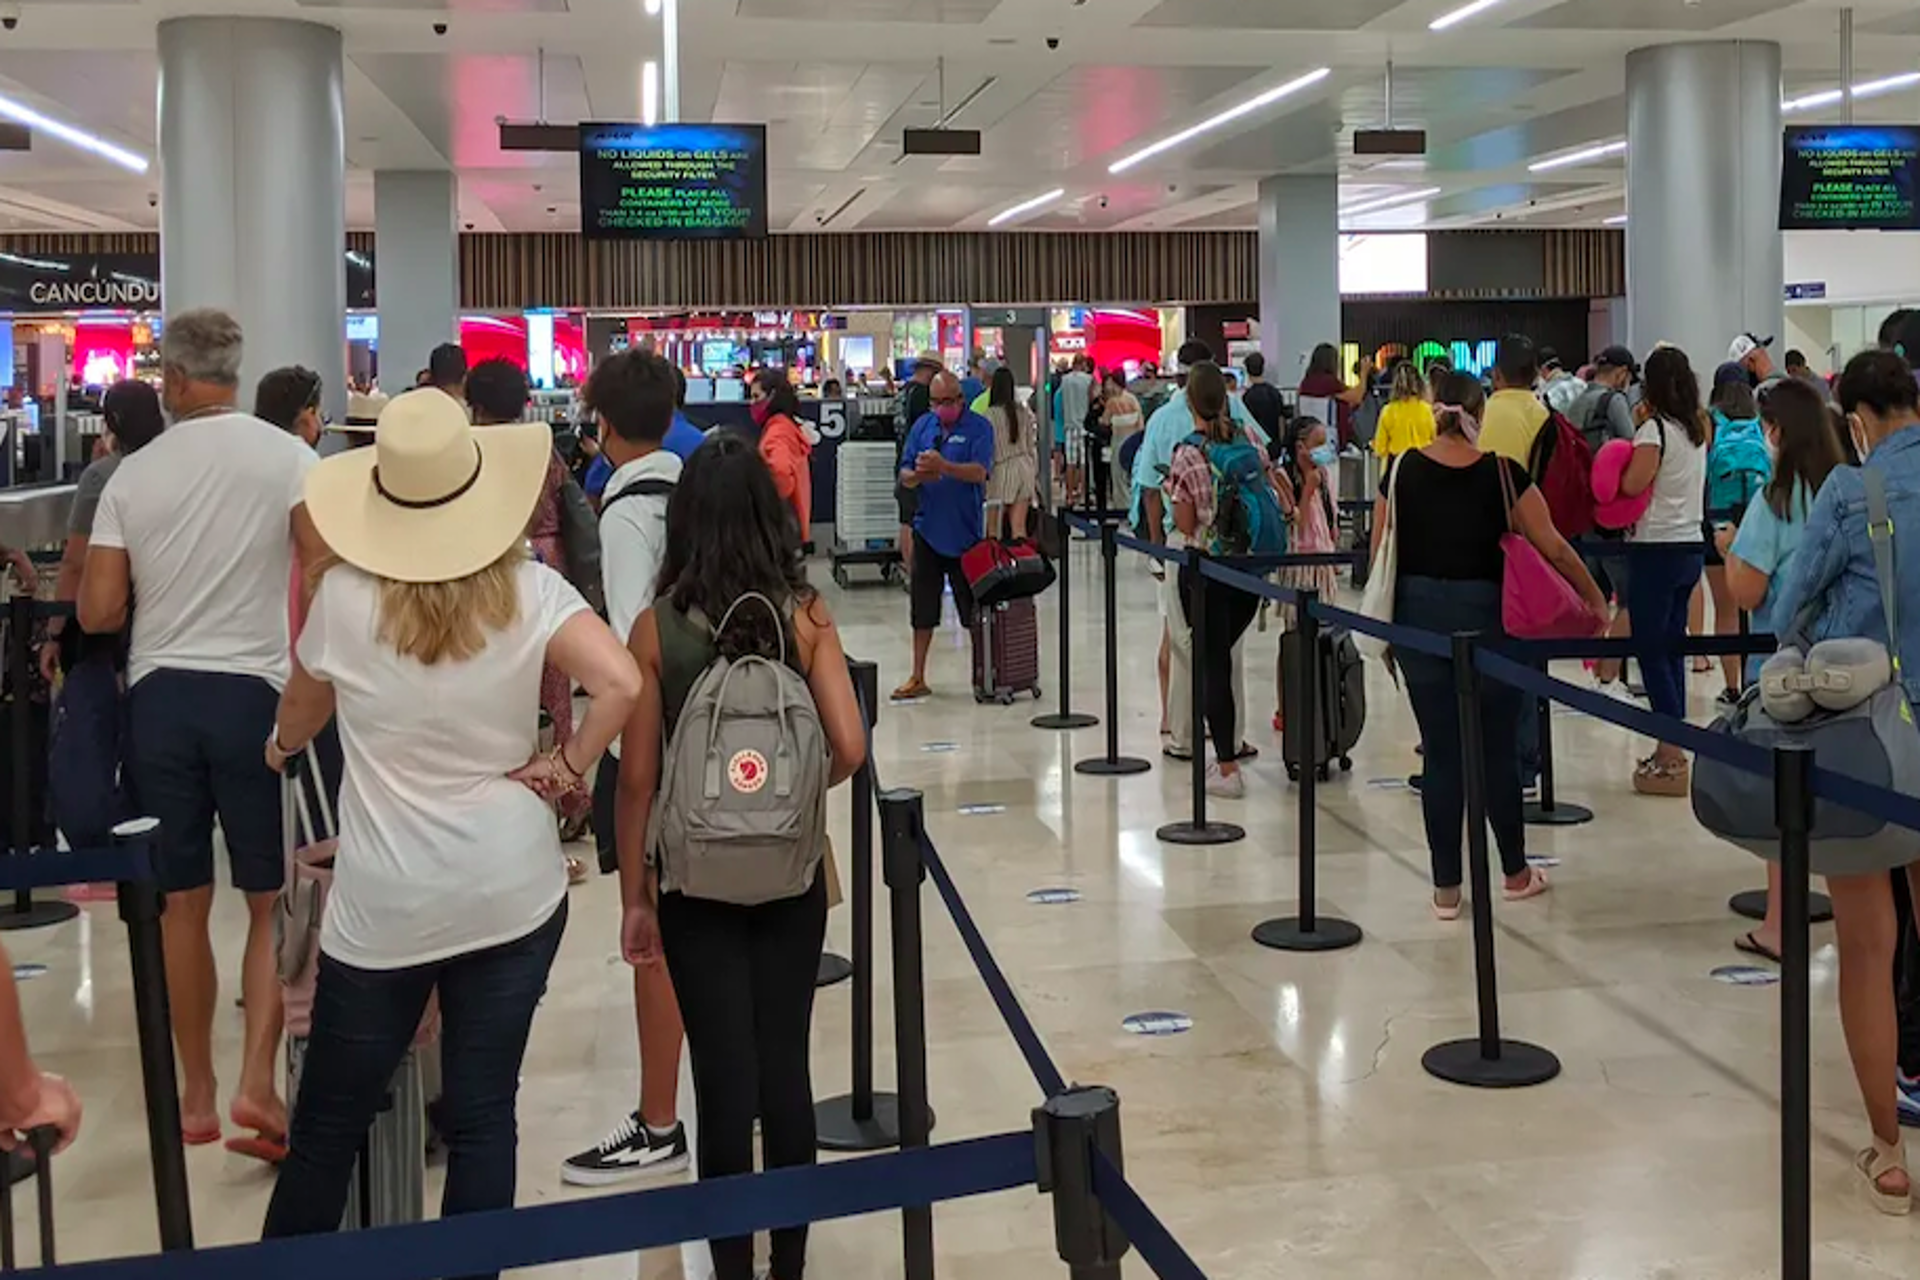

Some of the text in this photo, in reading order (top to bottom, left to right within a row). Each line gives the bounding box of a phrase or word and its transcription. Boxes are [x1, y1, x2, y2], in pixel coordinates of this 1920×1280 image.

[597, 149, 618, 159] NO
[621, 149, 675, 159] LIQUIDS
[694, 149, 728, 159] GELS
[1797, 149, 1814, 158] NO
[1816, 149, 1857, 158] LIQUIDS
[1873, 149, 1900, 158] GELS
[612, 161, 735, 170] ALLOWED THROUGH THE
[630, 170, 681, 179] SECURITY
[1822, 168, 1861, 176] SECURITY
[1812, 182, 1853, 192] PLEASE
[621, 187, 728, 198] PLEASE PLACE ALL
[619, 199, 731, 208] CONTAINERS OF MORE
[599, 209, 628, 217] THAN
[696, 208, 710, 217] IN
[714, 208, 751, 217] YOUR
[598, 217, 748, 228] CHECKED-IN BAGGAGE
[1006, 309, 1016, 324] 3
[819, 402, 846, 438] 5
